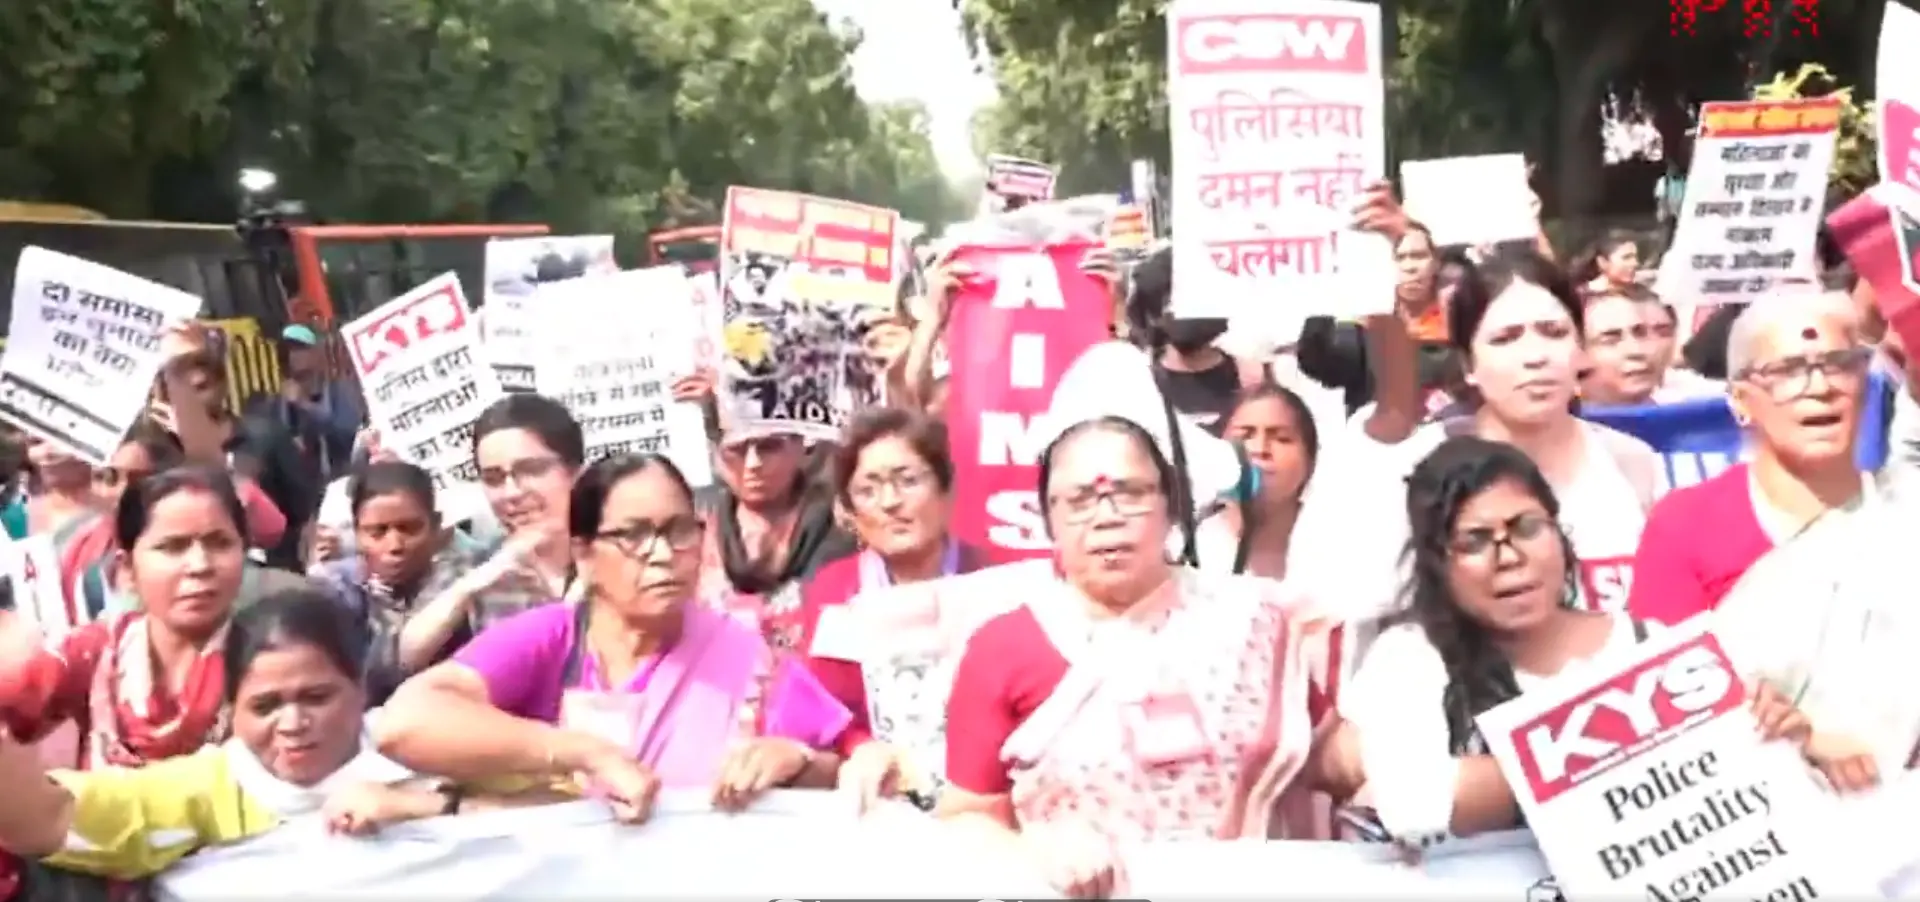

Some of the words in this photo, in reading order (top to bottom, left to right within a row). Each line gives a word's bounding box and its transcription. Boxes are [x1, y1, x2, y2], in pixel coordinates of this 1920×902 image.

[1199, 171, 1283, 208] दमन
[1526, 643, 1733, 784] KYS
[1603, 750, 1718, 823] Police
[1597, 780, 1773, 881] Brutality
